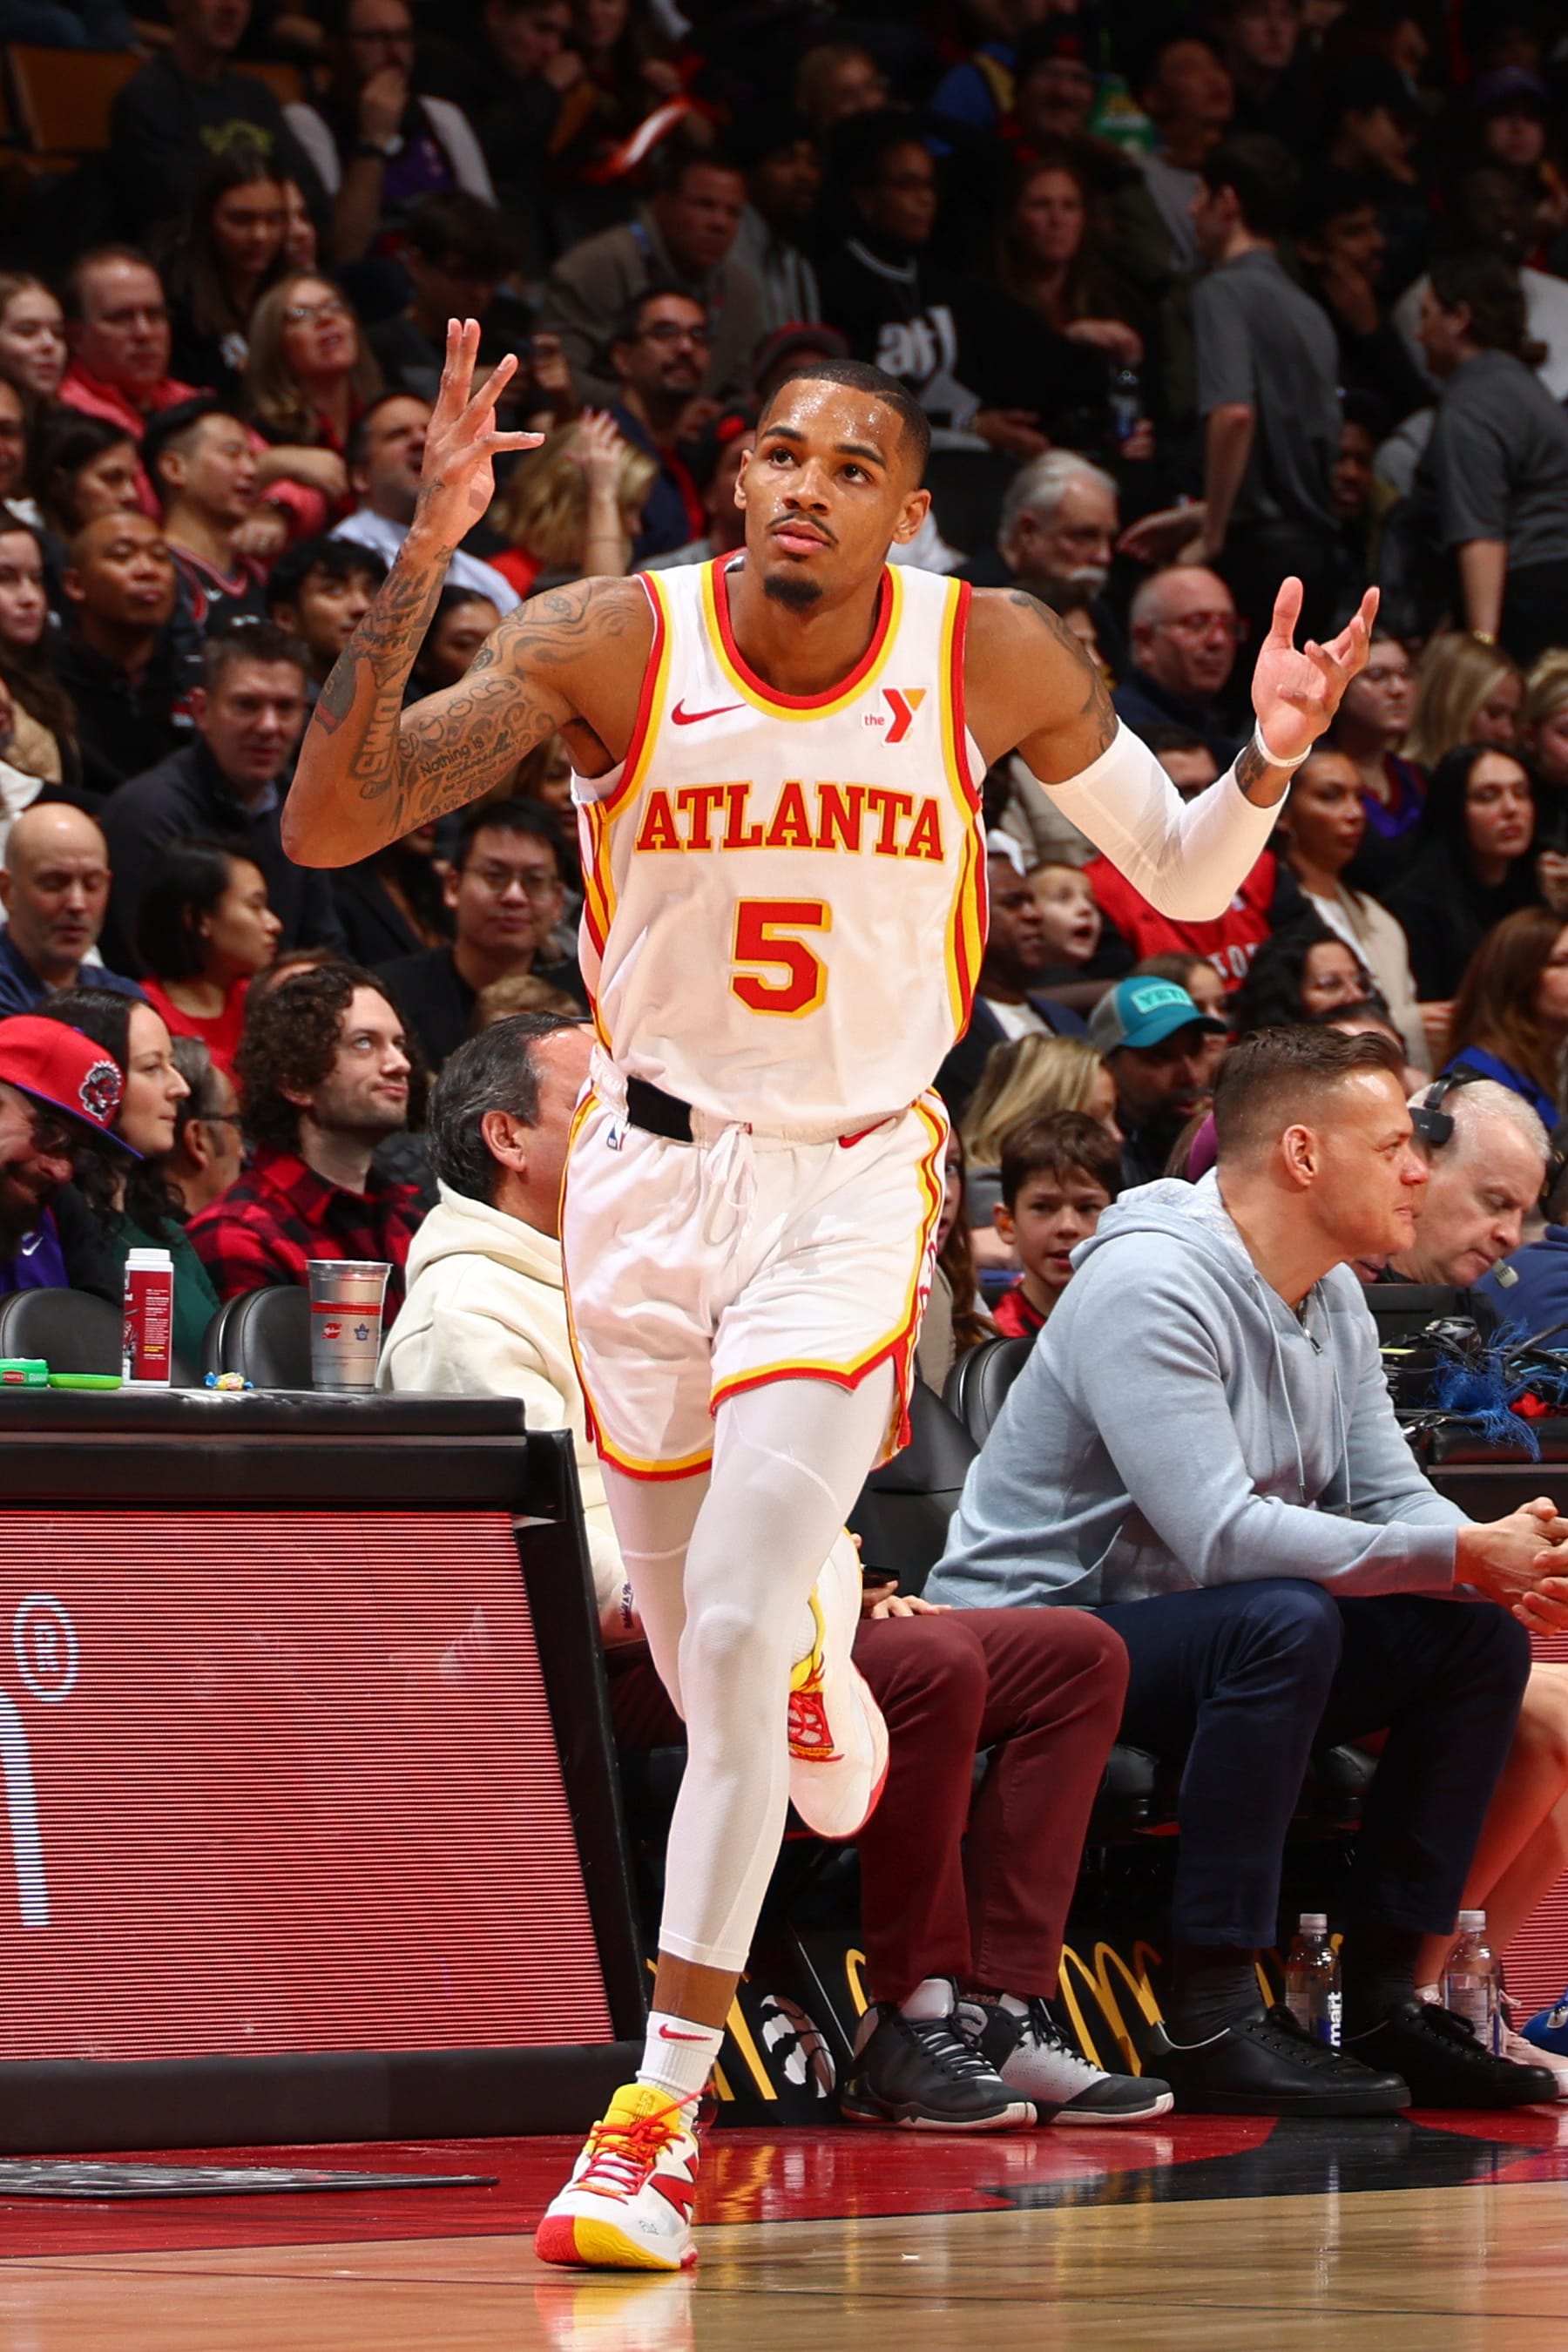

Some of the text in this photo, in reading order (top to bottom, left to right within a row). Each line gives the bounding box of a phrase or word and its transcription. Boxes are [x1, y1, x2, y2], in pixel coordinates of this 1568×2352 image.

[864, 713, 885, 726] the
[420, 744, 471, 776] Nothing
[473, 735, 485, 751] is
[635, 780, 944, 864] ATLANTA
[729, 898, 833, 1018] 5
